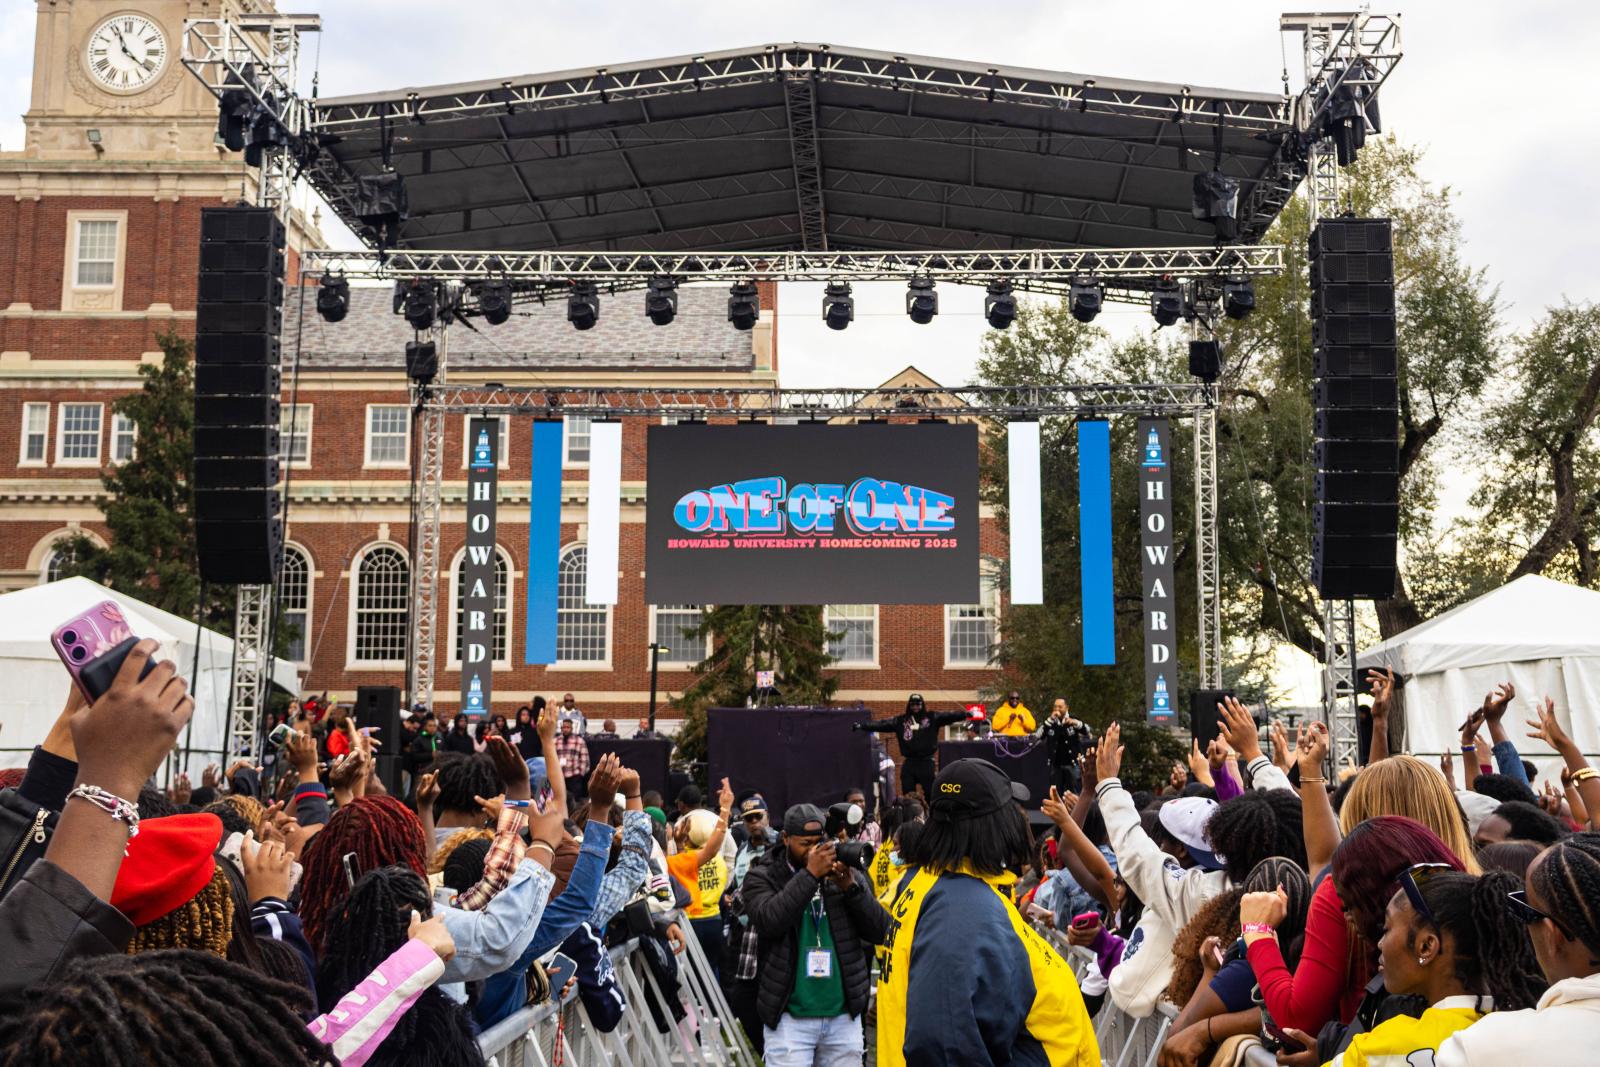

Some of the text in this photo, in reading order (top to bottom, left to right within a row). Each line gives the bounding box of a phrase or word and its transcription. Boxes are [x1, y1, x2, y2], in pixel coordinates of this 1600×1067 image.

[673, 475, 955, 536] ONE OF ONE
[668, 538, 958, 549] HOWARD UNIVERSITY HOMECOMING 2025
[468, 481, 492, 664] HOWARD
[1145, 481, 1169, 664] HOWARD
[940, 783, 962, 793] CSC
[698, 866, 718, 879] EVENT
